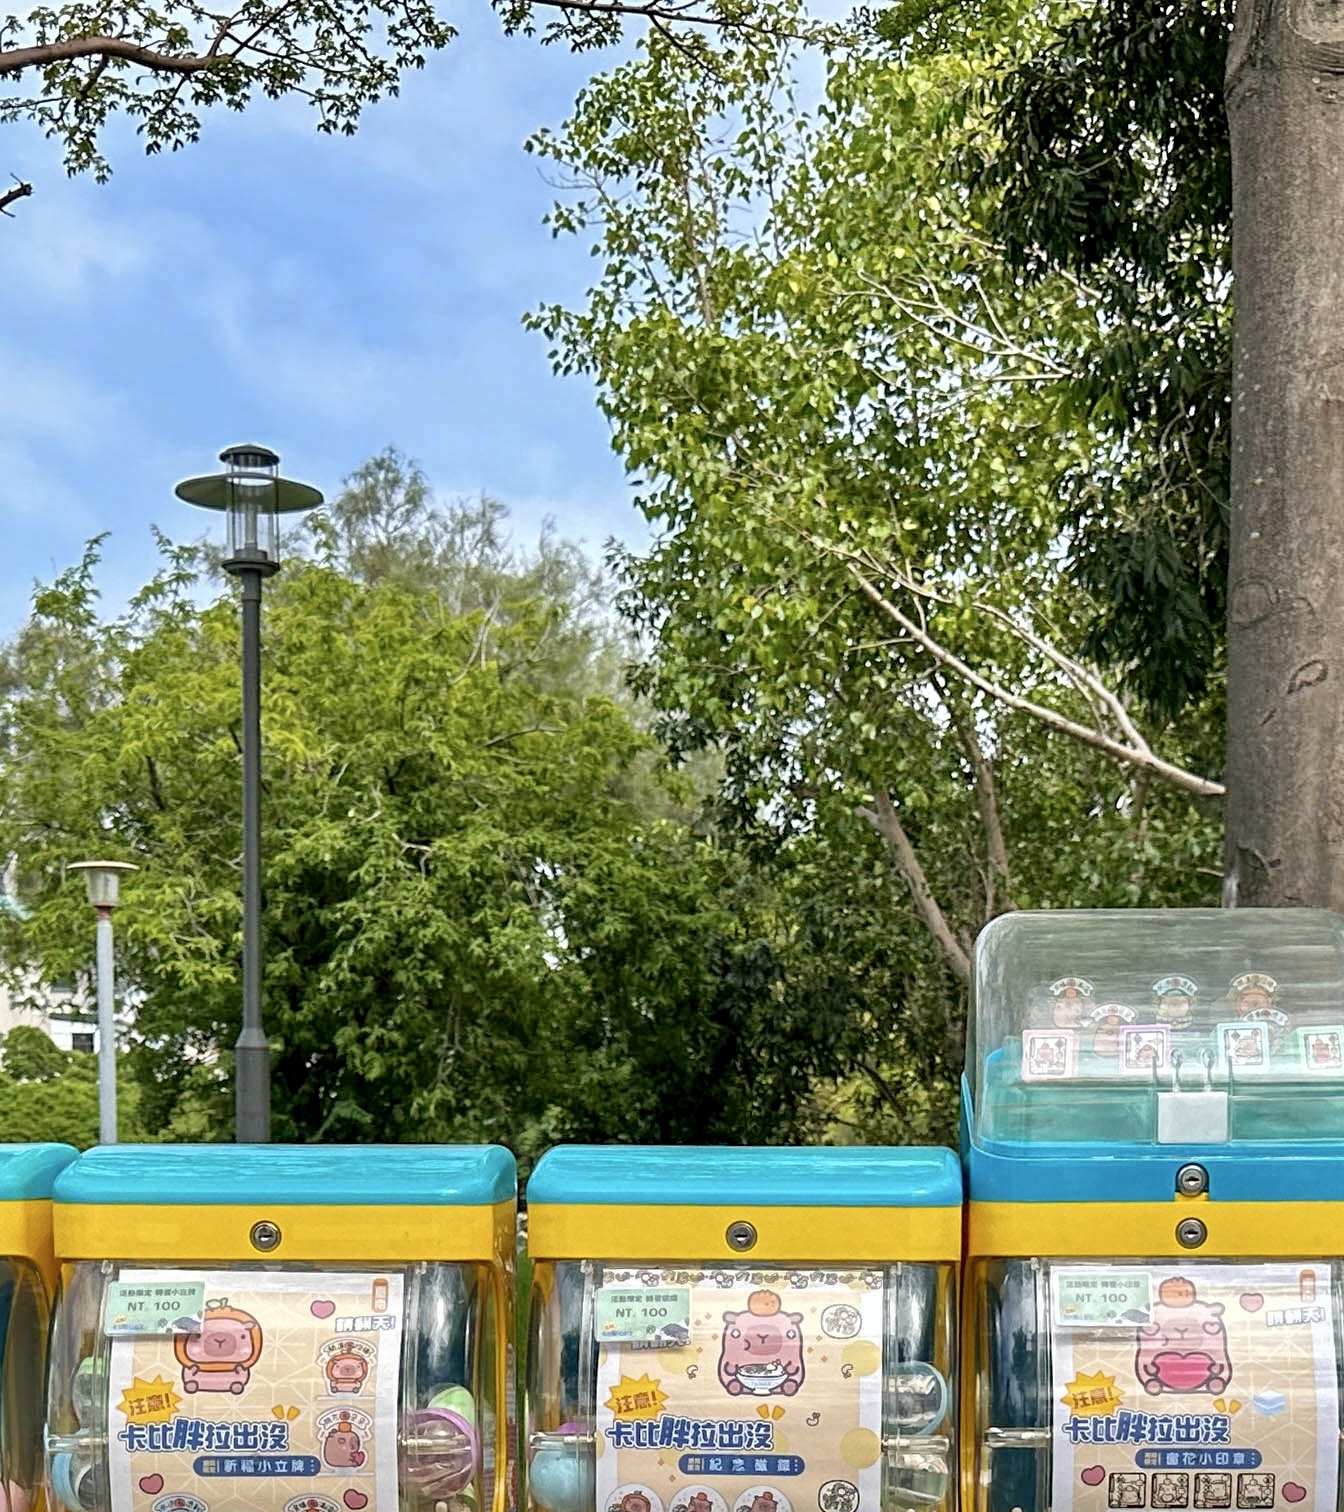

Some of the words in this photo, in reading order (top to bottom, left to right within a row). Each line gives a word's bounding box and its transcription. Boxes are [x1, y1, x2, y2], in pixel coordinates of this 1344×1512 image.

[154, 1300, 181, 1311] 100
[1100, 1292, 1128, 1303] 100
[643, 1306, 667, 1317] 100
[129, 1393, 170, 1417] 注意!
[616, 1391, 657, 1414] 注意!
[1072, 1387, 1113, 1410] 注意!
[117, 1416, 288, 1452] 卡比胖拉出沒
[606, 1414, 774, 1450] 卡比胖拉出沒
[1063, 1409, 1231, 1444] 卡比胖拉出沒
